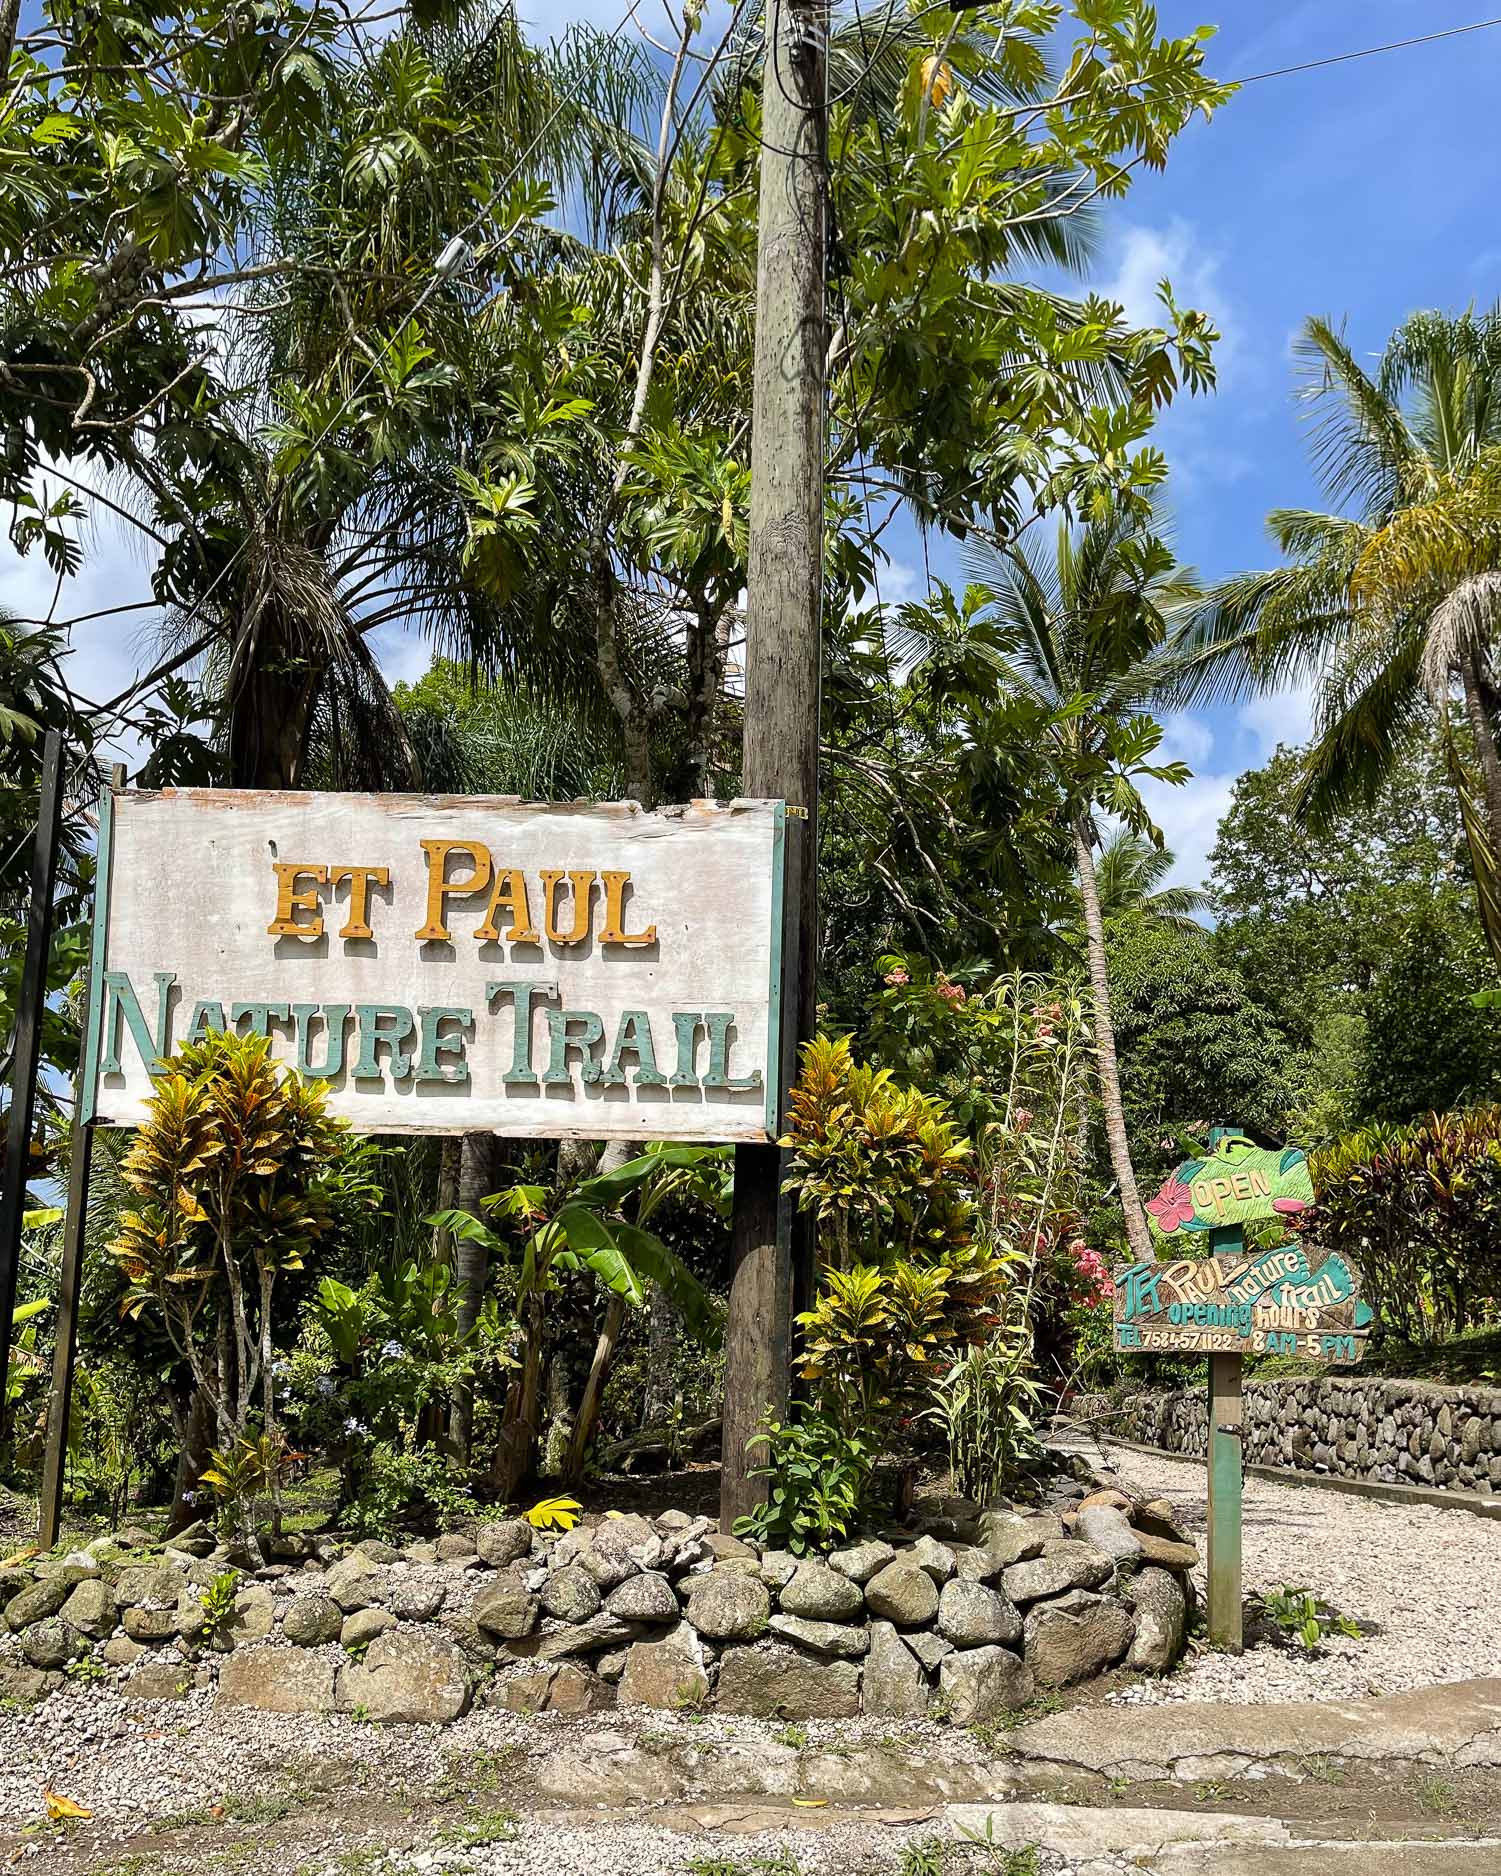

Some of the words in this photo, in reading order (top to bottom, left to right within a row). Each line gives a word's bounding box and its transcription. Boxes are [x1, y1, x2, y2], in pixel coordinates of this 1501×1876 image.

[267, 863, 390, 939] ET
[415, 839, 657, 945] PAUL
[486, 980, 762, 1088] TRAIL
[1193, 1168, 1272, 1217] OPEN
[1162, 1258, 1249, 1304] PAUL
[1231, 1253, 1299, 1304] nature
[1279, 1273, 1342, 1308] trail
[1168, 1303, 1252, 1337] opening
[1256, 1304, 1320, 1330] hours
